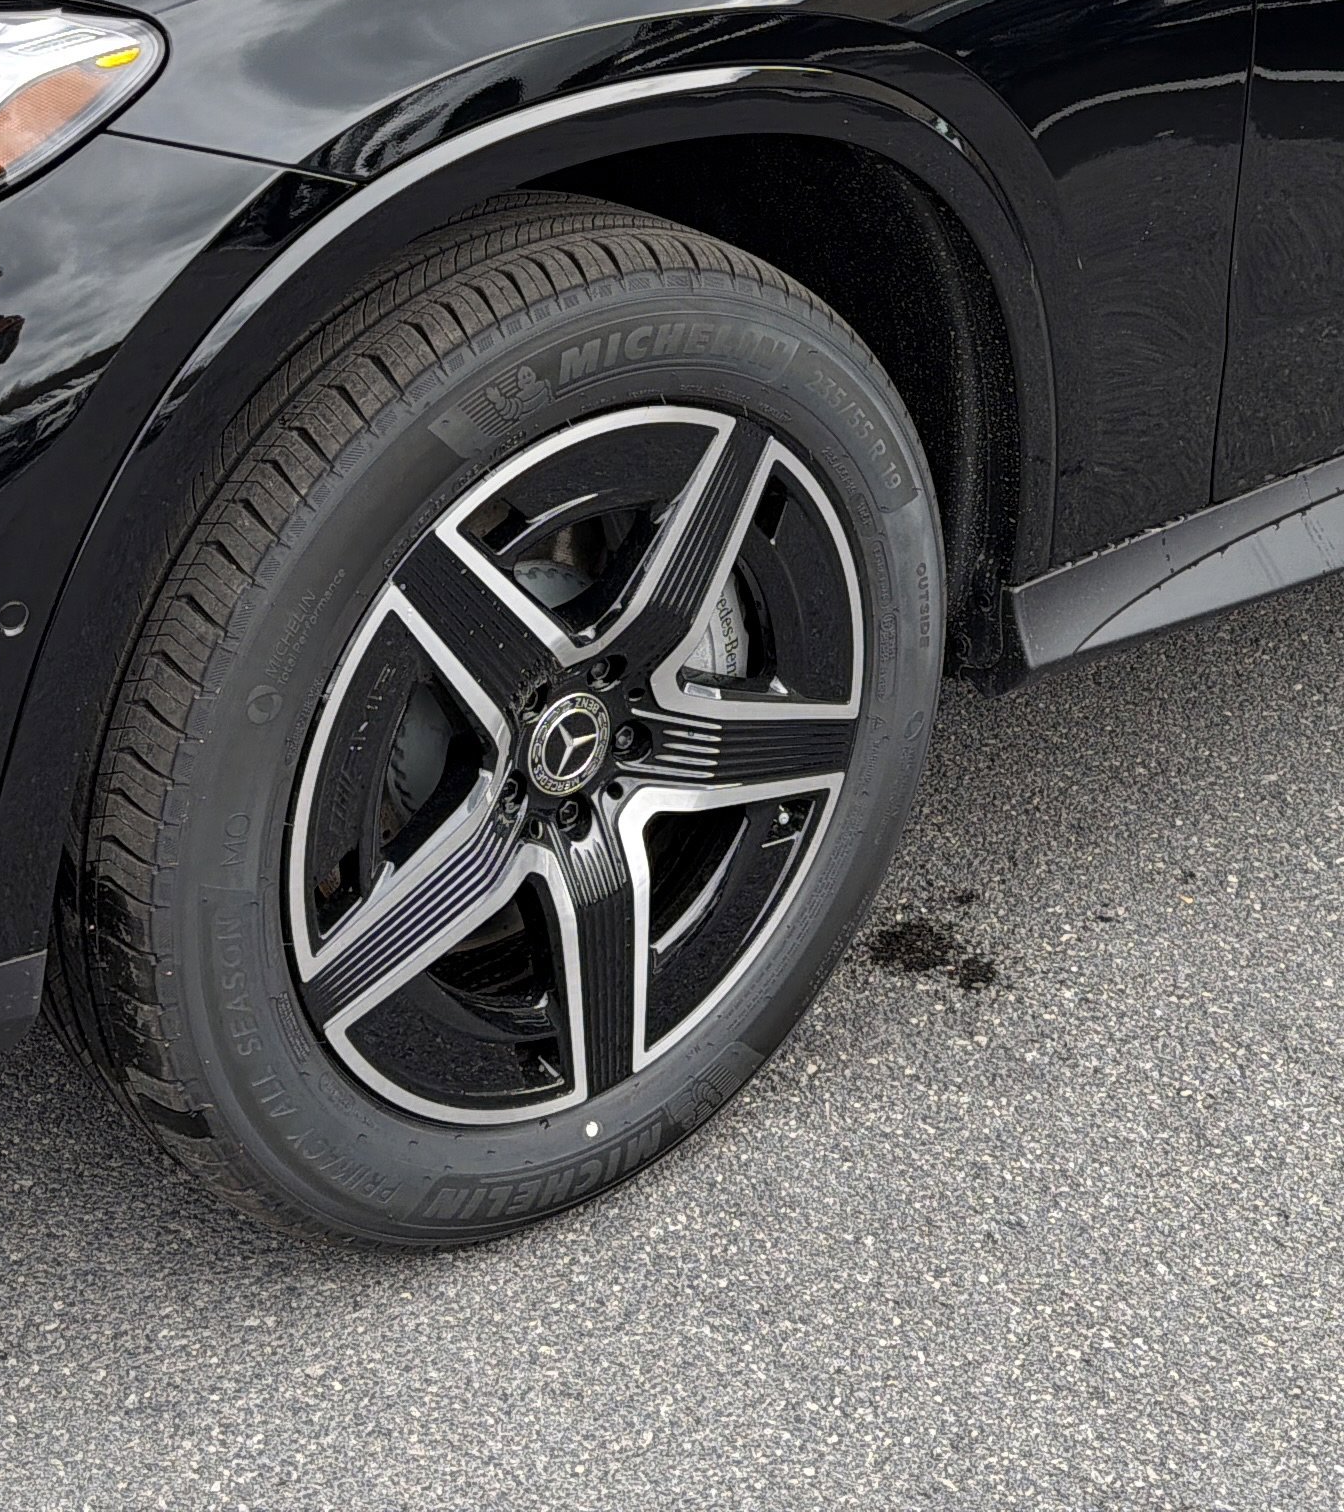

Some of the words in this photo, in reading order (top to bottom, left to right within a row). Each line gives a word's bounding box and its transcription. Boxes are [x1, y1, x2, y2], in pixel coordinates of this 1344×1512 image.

[558, 322, 788, 385] MICHELIN
[804, 369, 875, 439] 235/55
[870, 438, 887, 462] R
[881, 461, 903, 489] 19
[264, 589, 317, 679] MICHELIN
[915, 561, 931, 650] OUTSIDE
[574, 696, 601, 715] BENZ
[533, 763, 580, 792] MERCEDES
[217, 914, 264, 1057] SEASON
[250, 1065, 297, 1119] ALL
[284, 1127, 404, 1207] PRIMACY
[421, 1120, 665, 1220] MICHELIN
